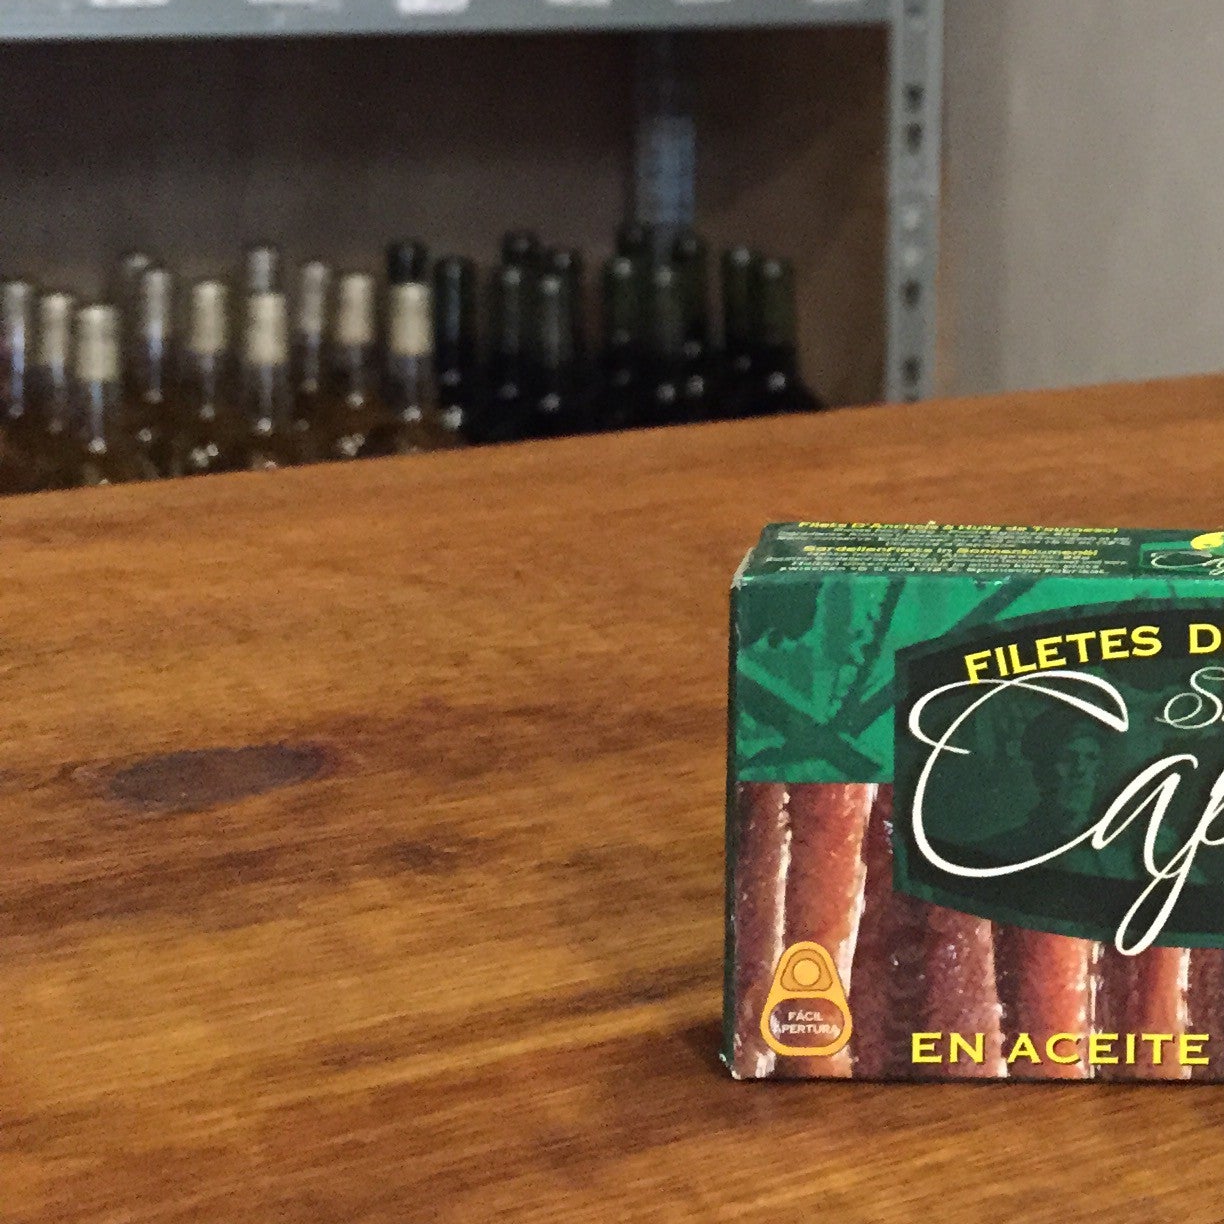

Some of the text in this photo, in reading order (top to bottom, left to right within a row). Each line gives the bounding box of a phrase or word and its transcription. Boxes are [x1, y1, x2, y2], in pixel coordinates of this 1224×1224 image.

[966, 625, 1162, 684] FILETES
[787, 1010, 824, 1022] FÁCIL
[911, 1032, 987, 1065] EN
[1007, 1032, 1211, 1066] ACEITE
